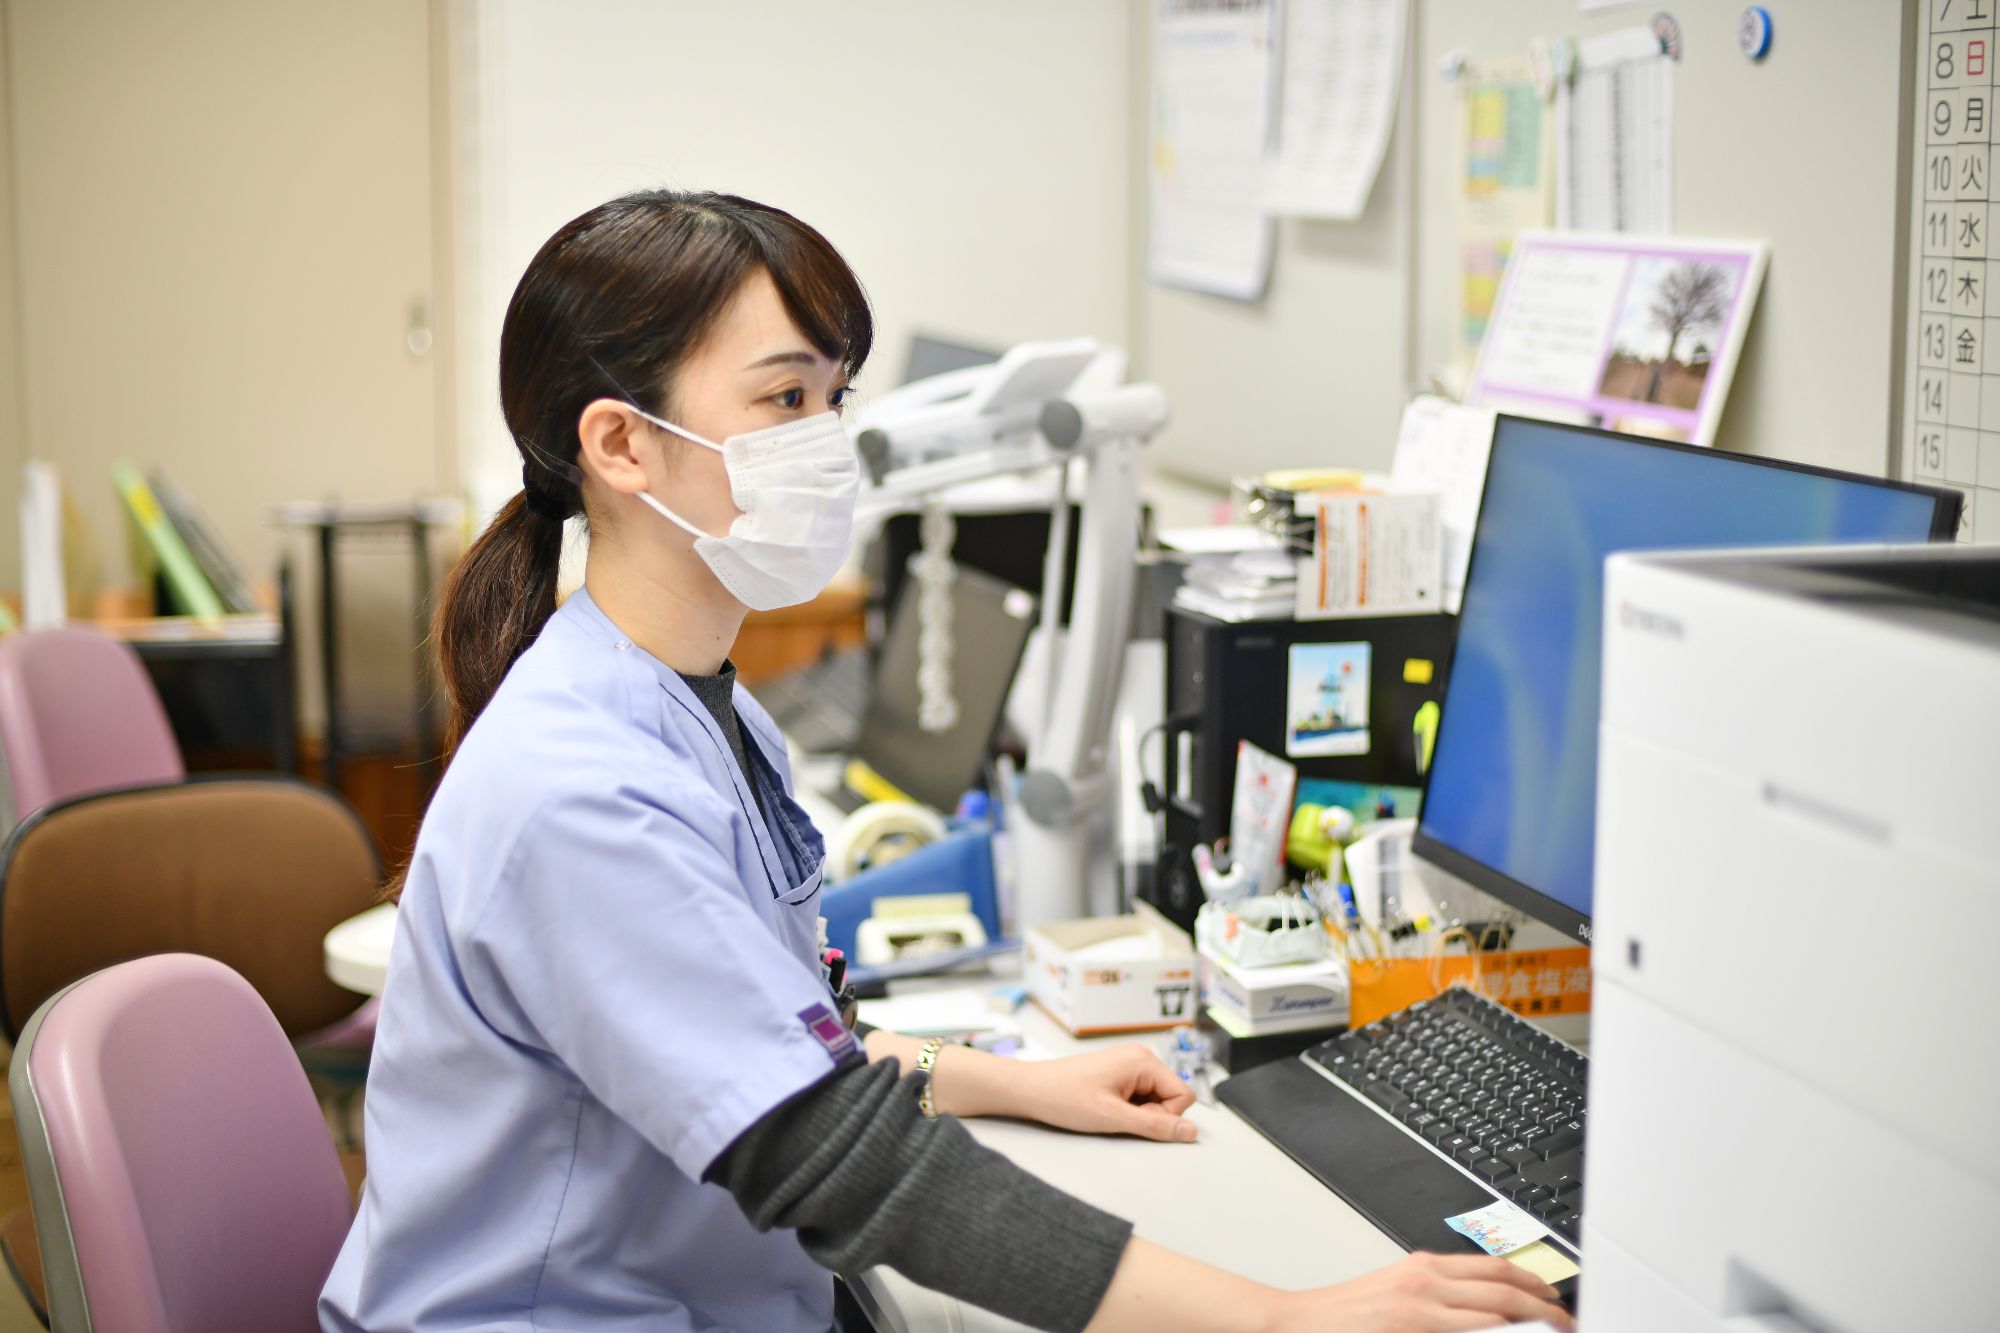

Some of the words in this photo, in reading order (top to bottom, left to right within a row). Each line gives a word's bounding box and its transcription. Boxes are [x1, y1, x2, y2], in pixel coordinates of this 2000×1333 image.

[1936, 43, 1953, 79] 8
[1967, 40, 1985, 76] 日
[1934, 100, 1952, 136] 9
[1964, 97, 1984, 133] 月
[1931, 155, 1951, 191] 10
[1961, 154, 1982, 191] 火
[1929, 212, 1948, 247] 11
[1959, 212, 1981, 248] 水
[1927, 267, 1948, 303] 12
[1957, 271, 1979, 306] 木
[1924, 323, 1945, 360] 13
[1955, 328, 1976, 364] 金
[1922, 378, 1942, 414] 14
[1920, 434, 1940, 470] 15
